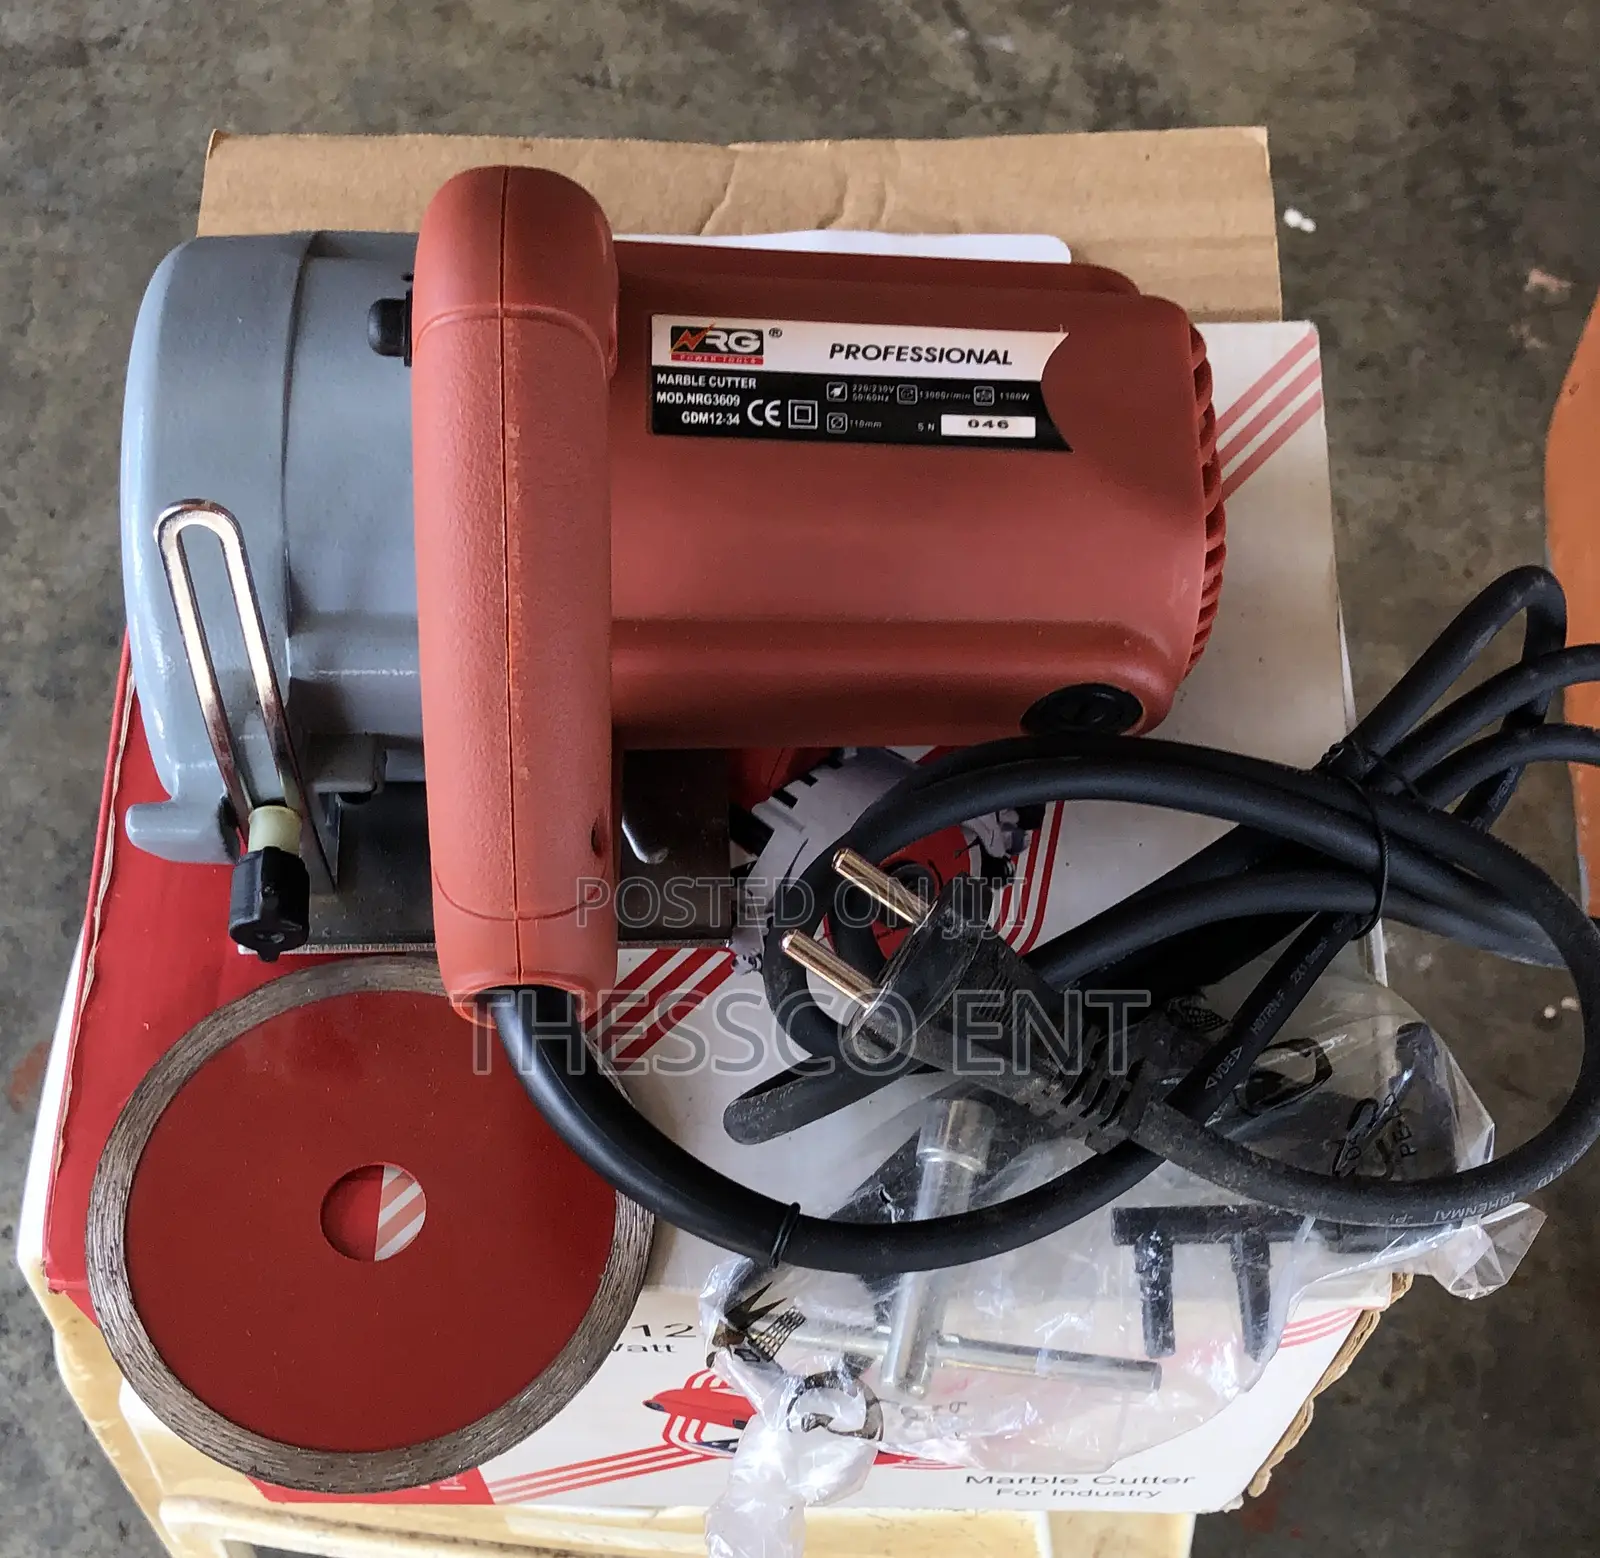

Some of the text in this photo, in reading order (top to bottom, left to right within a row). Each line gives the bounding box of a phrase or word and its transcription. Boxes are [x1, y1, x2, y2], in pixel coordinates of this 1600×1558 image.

[670, 323, 763, 356] NRG
[829, 342, 1014, 366] PROFESSIONAL
[656, 372, 757, 390] MARBLE CUTTER
[681, 410, 741, 426] GDM12-34
[746, 399, 782, 427] CE
[965, 1475, 1196, 1485] Marble Cutter
[996, 1488, 1162, 1498] For Industry
